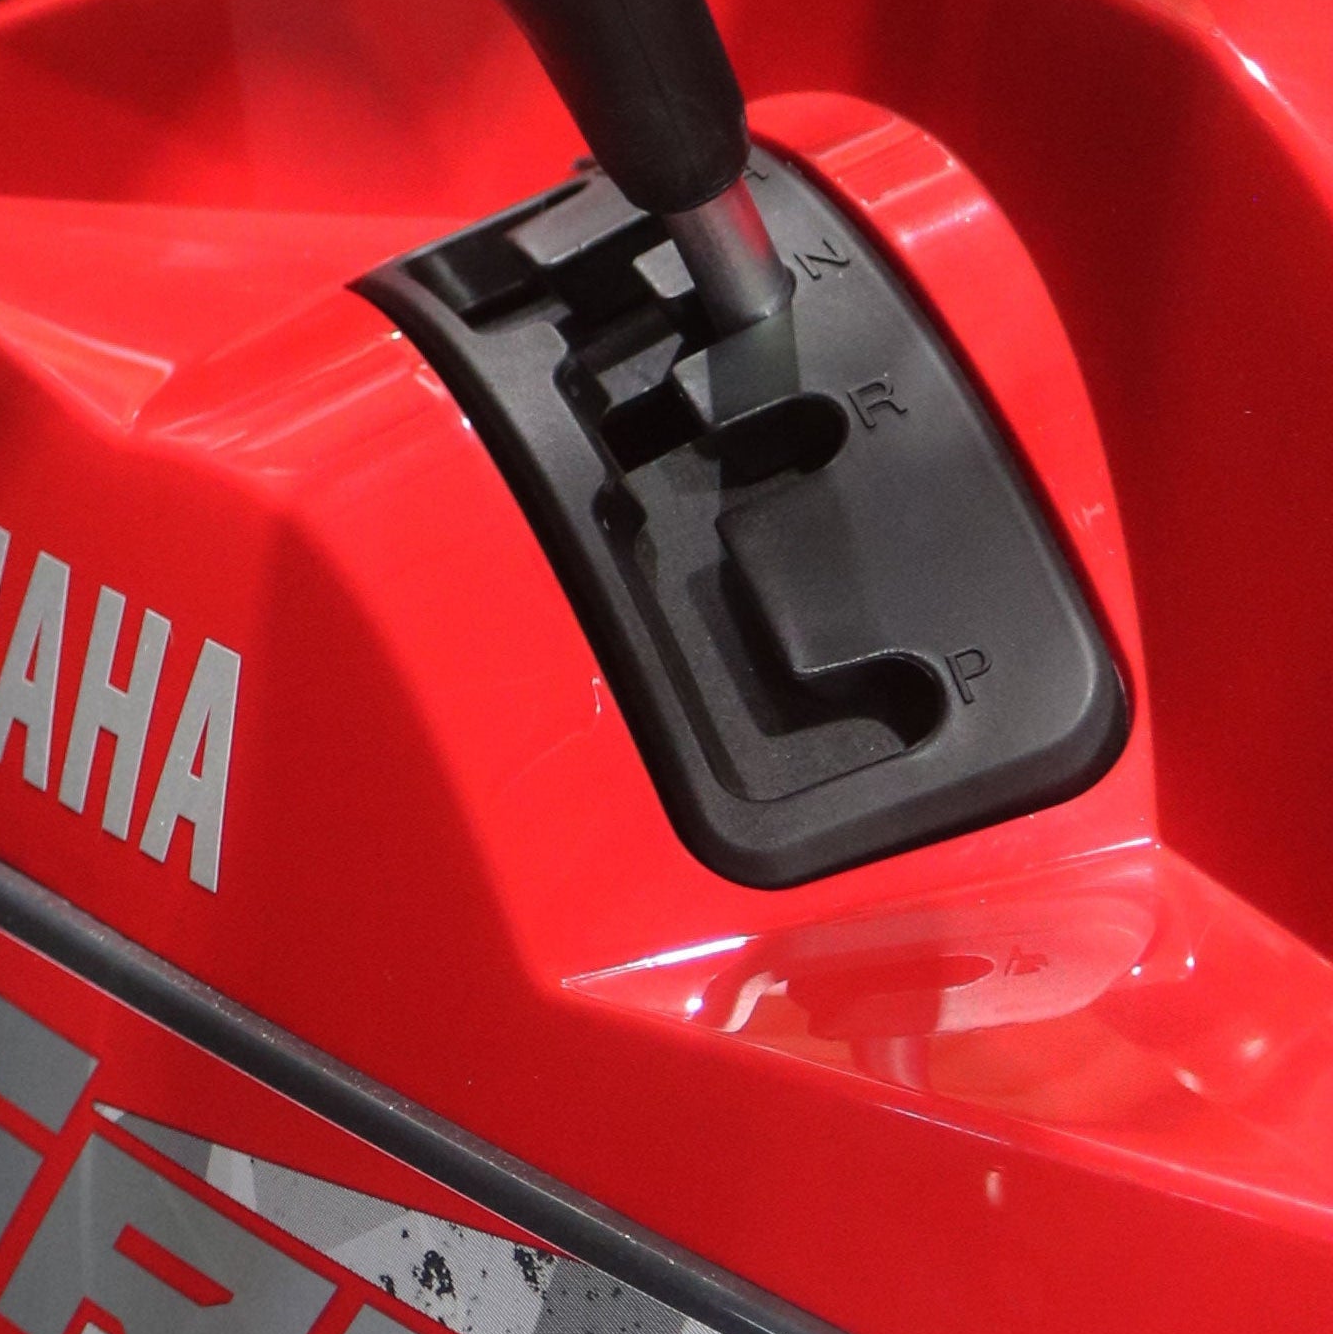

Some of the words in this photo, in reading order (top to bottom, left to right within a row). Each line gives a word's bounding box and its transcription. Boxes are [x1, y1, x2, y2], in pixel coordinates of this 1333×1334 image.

[794, 238, 850, 281] N
[847, 377, 907, 431] R
[945, 647, 994, 705] P
